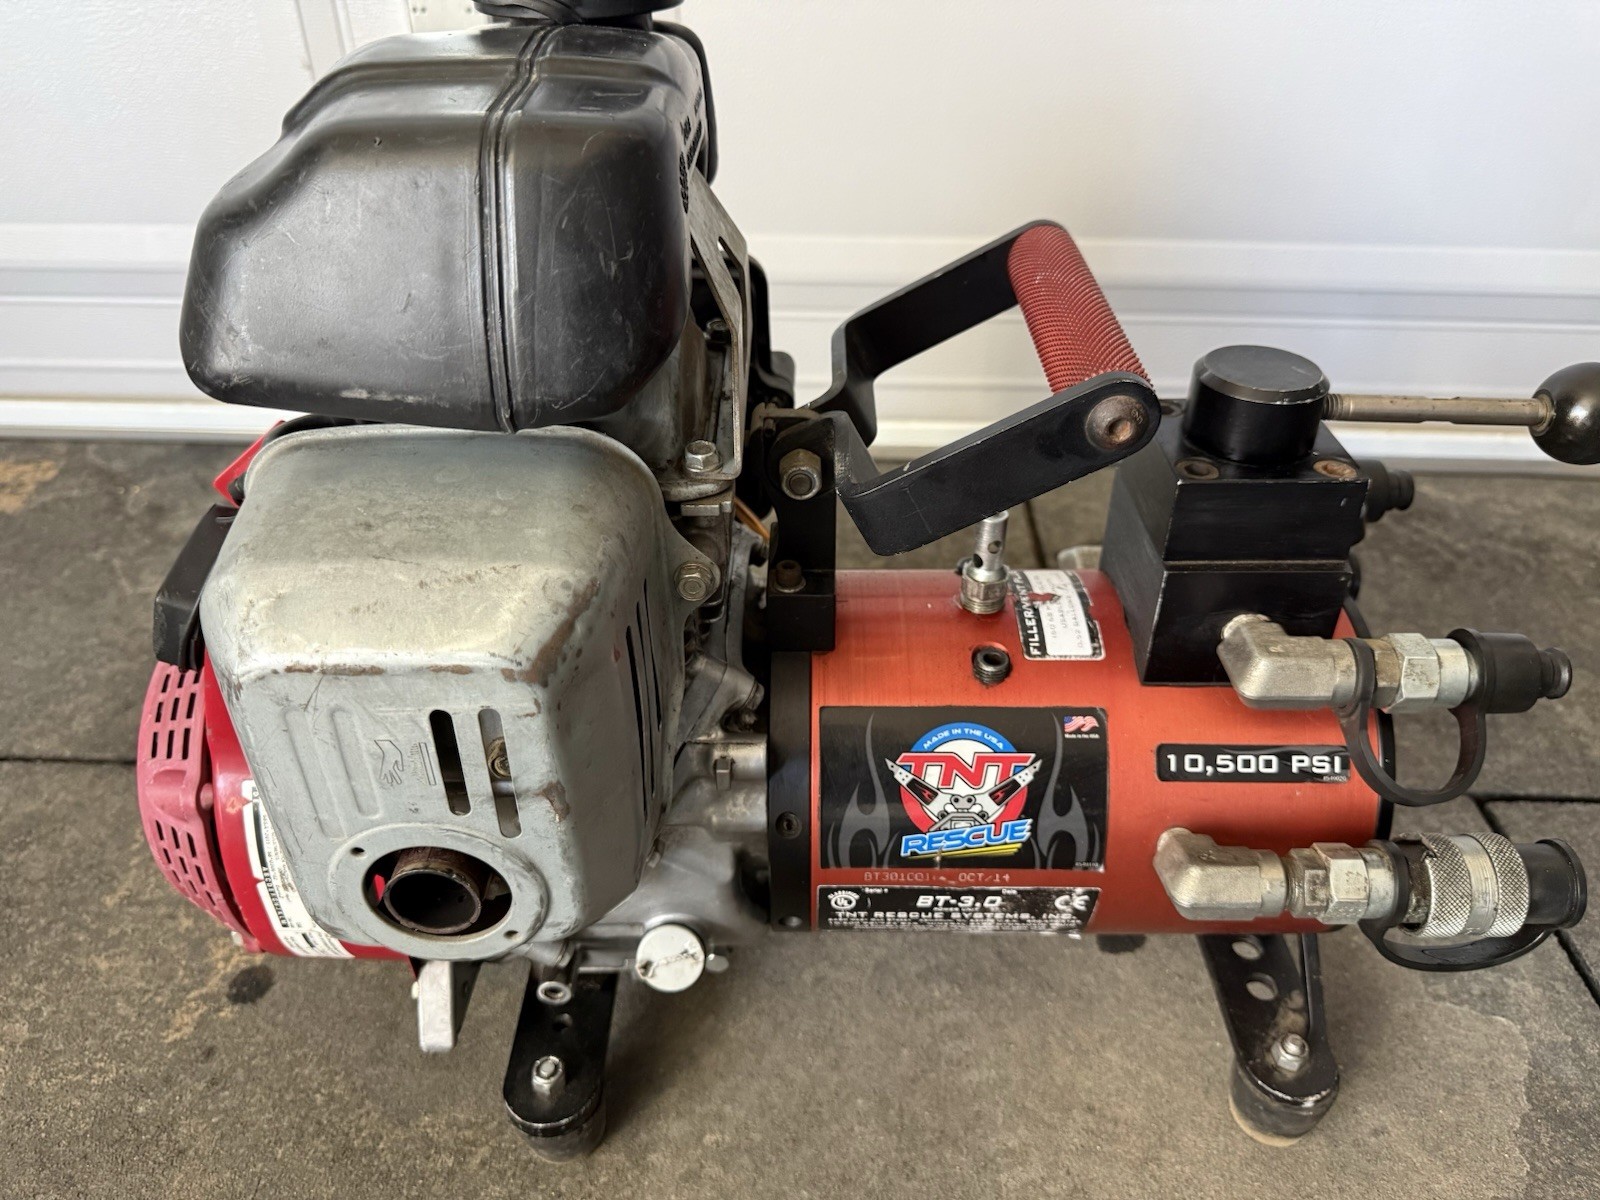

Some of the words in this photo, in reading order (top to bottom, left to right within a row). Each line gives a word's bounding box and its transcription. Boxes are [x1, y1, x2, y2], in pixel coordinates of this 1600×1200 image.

[923, 731, 950, 749] MADE
[964, 728, 983, 736] THE
[983, 733, 1004, 749] USA
[895, 752, 1036, 789] TNT
[1167, 753, 1279, 776] 10,500
[1291, 754, 1342, 774] PSI
[900, 818, 1033, 858] RESCUE
[916, 895, 1003, 908] BT-3.0
[835, 911, 868, 919] TNT
[873, 911, 945, 919] RESCUE
